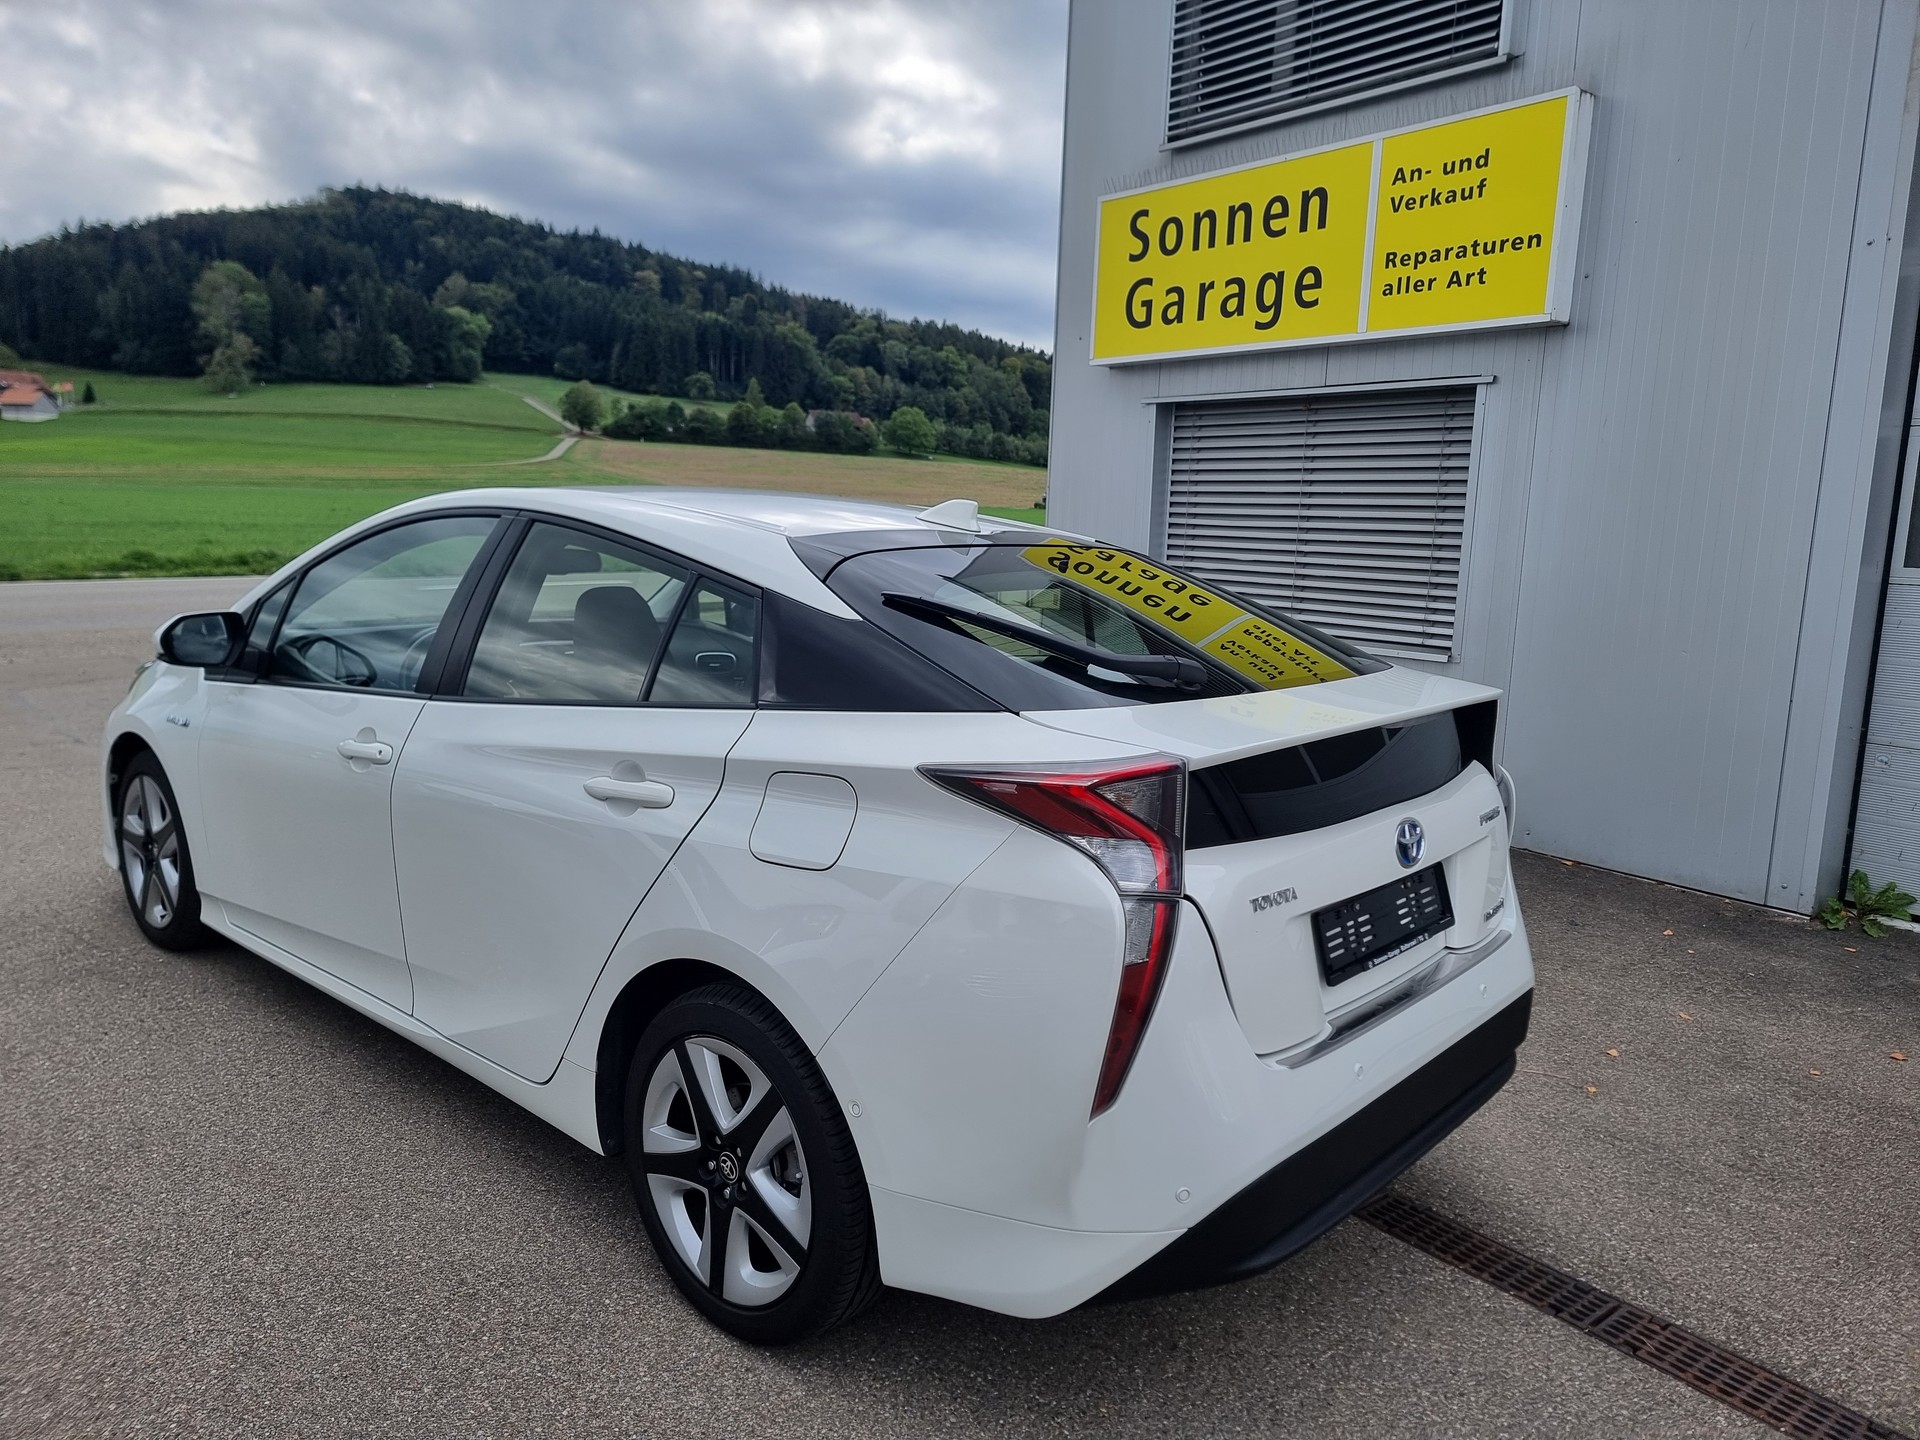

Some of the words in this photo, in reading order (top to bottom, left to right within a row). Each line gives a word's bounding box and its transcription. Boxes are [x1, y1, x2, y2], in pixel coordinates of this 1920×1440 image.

[1391, 167, 1433, 187] An-
[1442, 147, 1491, 176] und
[1390, 177, 1489, 214] Verkauf
[1127, 186, 1330, 264] Sonnen
[1384, 232, 1543, 271] Reparaturen
[1125, 265, 1323, 331] Garage
[1381, 275, 1437, 298] aller
[1445, 266, 1488, 289] Art
[1249, 886, 1298, 914] TOYOTA
